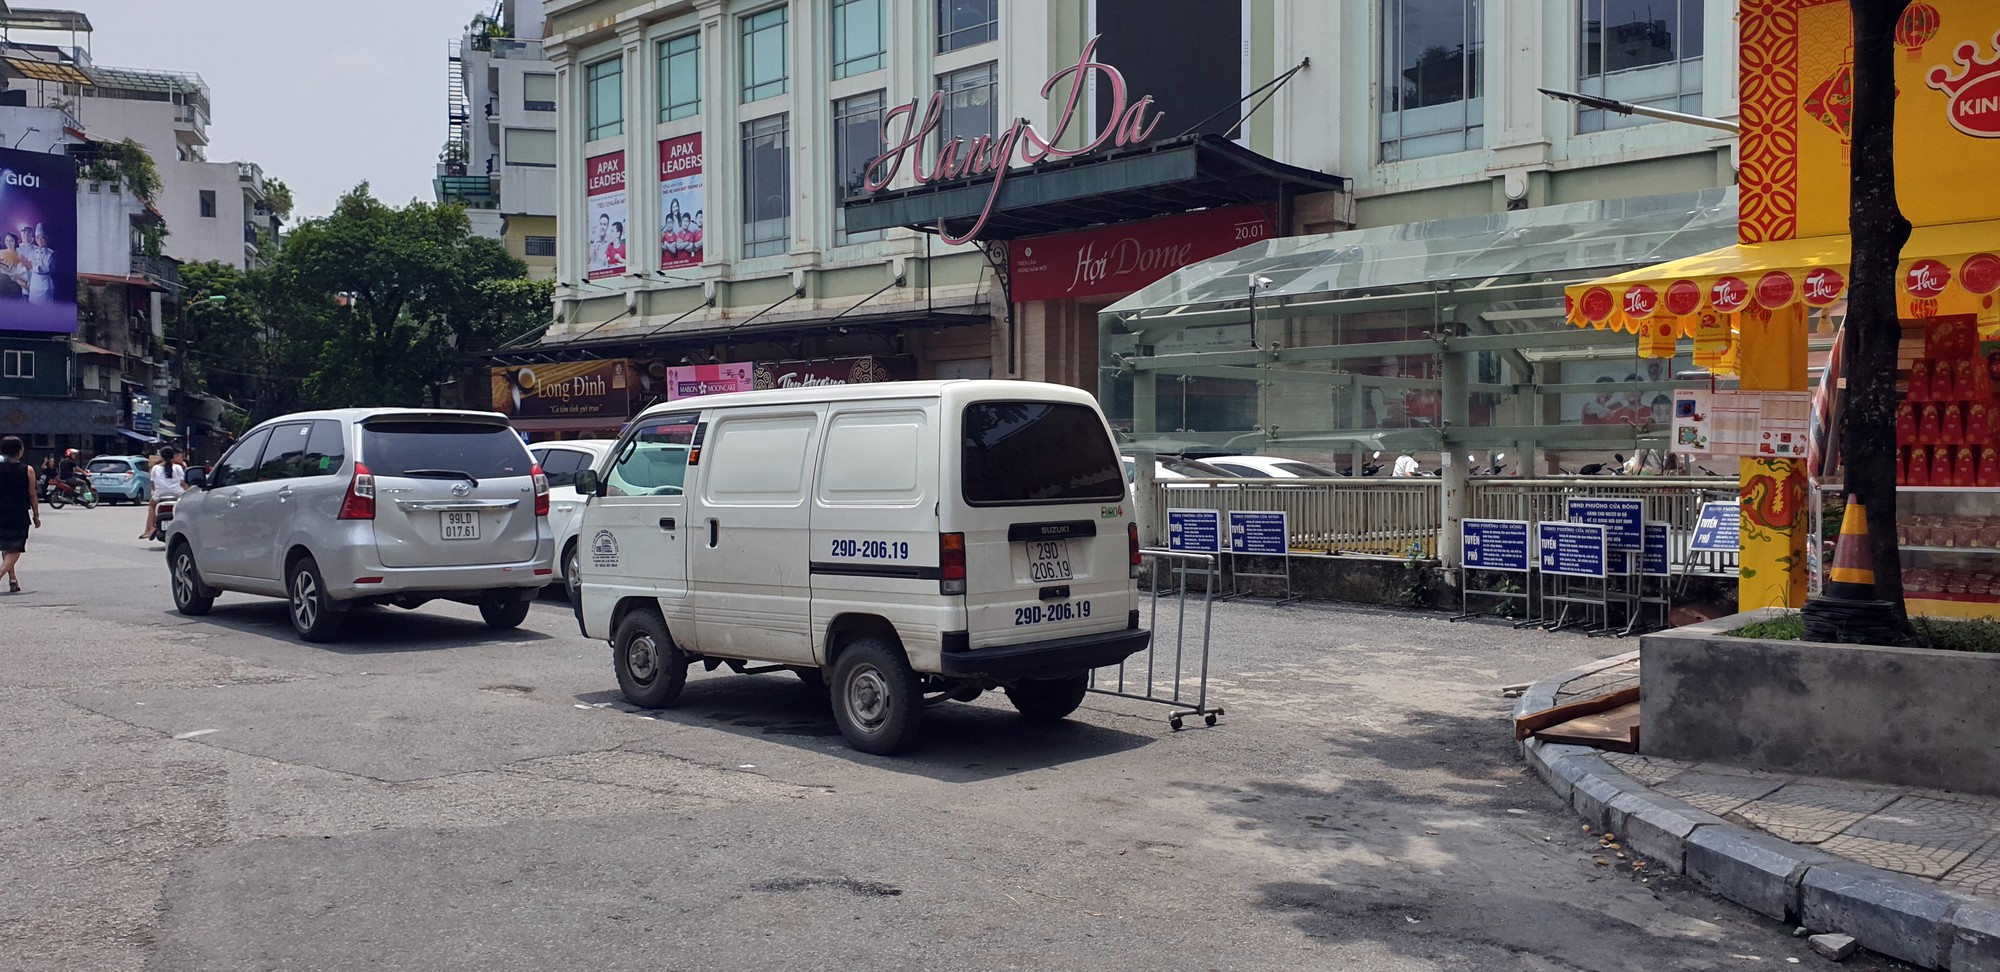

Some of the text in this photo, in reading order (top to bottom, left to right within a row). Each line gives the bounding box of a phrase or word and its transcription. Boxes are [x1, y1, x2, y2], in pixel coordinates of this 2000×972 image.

[1959, 94, 2000, 117] KIN
[670, 141, 694, 158] APAX
[597, 158, 619, 175] APAX
[661, 153, 703, 174] LEADERS
[864, 90, 1030, 245] Hang
[5, 172, 40, 188] GIỚI
[589, 170, 626, 190] LEADERS
[1235, 224, 1264, 240] 20.01
[1066, 237, 1192, 292] Hợi Dome
[1805, 272, 1840, 298] Thu
[1908, 264, 1945, 292] Thu
[1624, 288, 1655, 313] Thu
[1711, 280, 1748, 306] Thu
[537, 374, 606, 403] Long Đình
[680, 383, 737, 393] MAISON MOONCAKE
[449, 513, 472, 524] 99LD
[1170, 522, 1182, 532] TUYẾN
[445, 526, 475, 537] 017.61
[1041, 525, 1070, 534] SUZUKI
[1231, 522, 1245, 534] TUYẾN
[1172, 535, 1181, 545] PHỐ
[1234, 536, 1244, 547] PHỐ
[1464, 532, 1480, 545] TUYẾN
[1541, 537, 1556, 549] TUYẾN
[831, 539, 909, 560] 29D-206.19
[1036, 542, 1059, 560] 29D
[1467, 548, 1478, 560] PHỐ
[1543, 553, 1554, 565] PHỐ
[1032, 560, 1071, 580] 206.19
[1014, 600, 1091, 626] 29D-206.19
